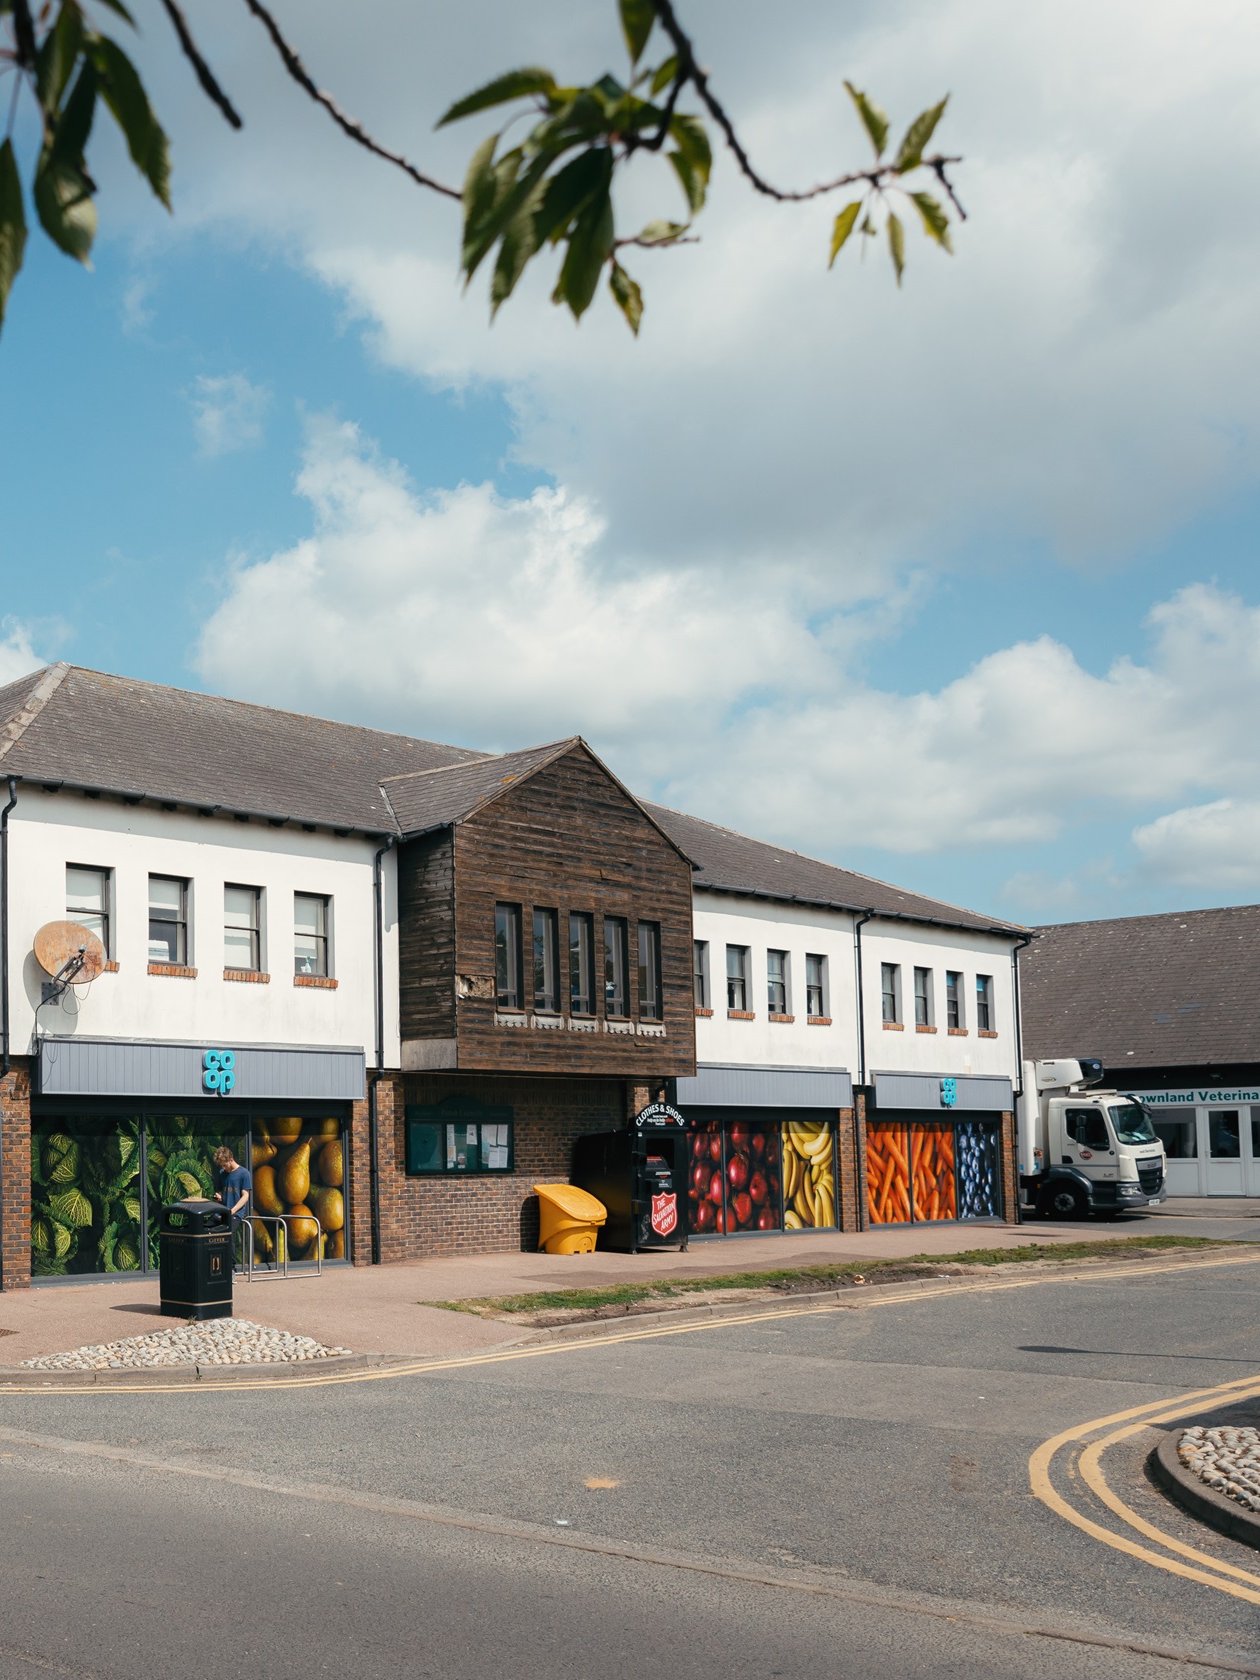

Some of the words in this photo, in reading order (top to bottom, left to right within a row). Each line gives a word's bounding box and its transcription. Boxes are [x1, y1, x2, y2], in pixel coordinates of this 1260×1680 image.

[1127, 1092, 1194, 1104] ownland
[1198, 1090, 1260, 1101] Veterina
[635, 1104, 659, 1127] CLOTHES
[659, 1104, 665, 1113] &
[665, 1105, 685, 1127] SHOES
[657, 1198, 666, 1210] THE
[653, 1203, 675, 1225] SALVATION
[661, 1212, 674, 1231] ARMY
